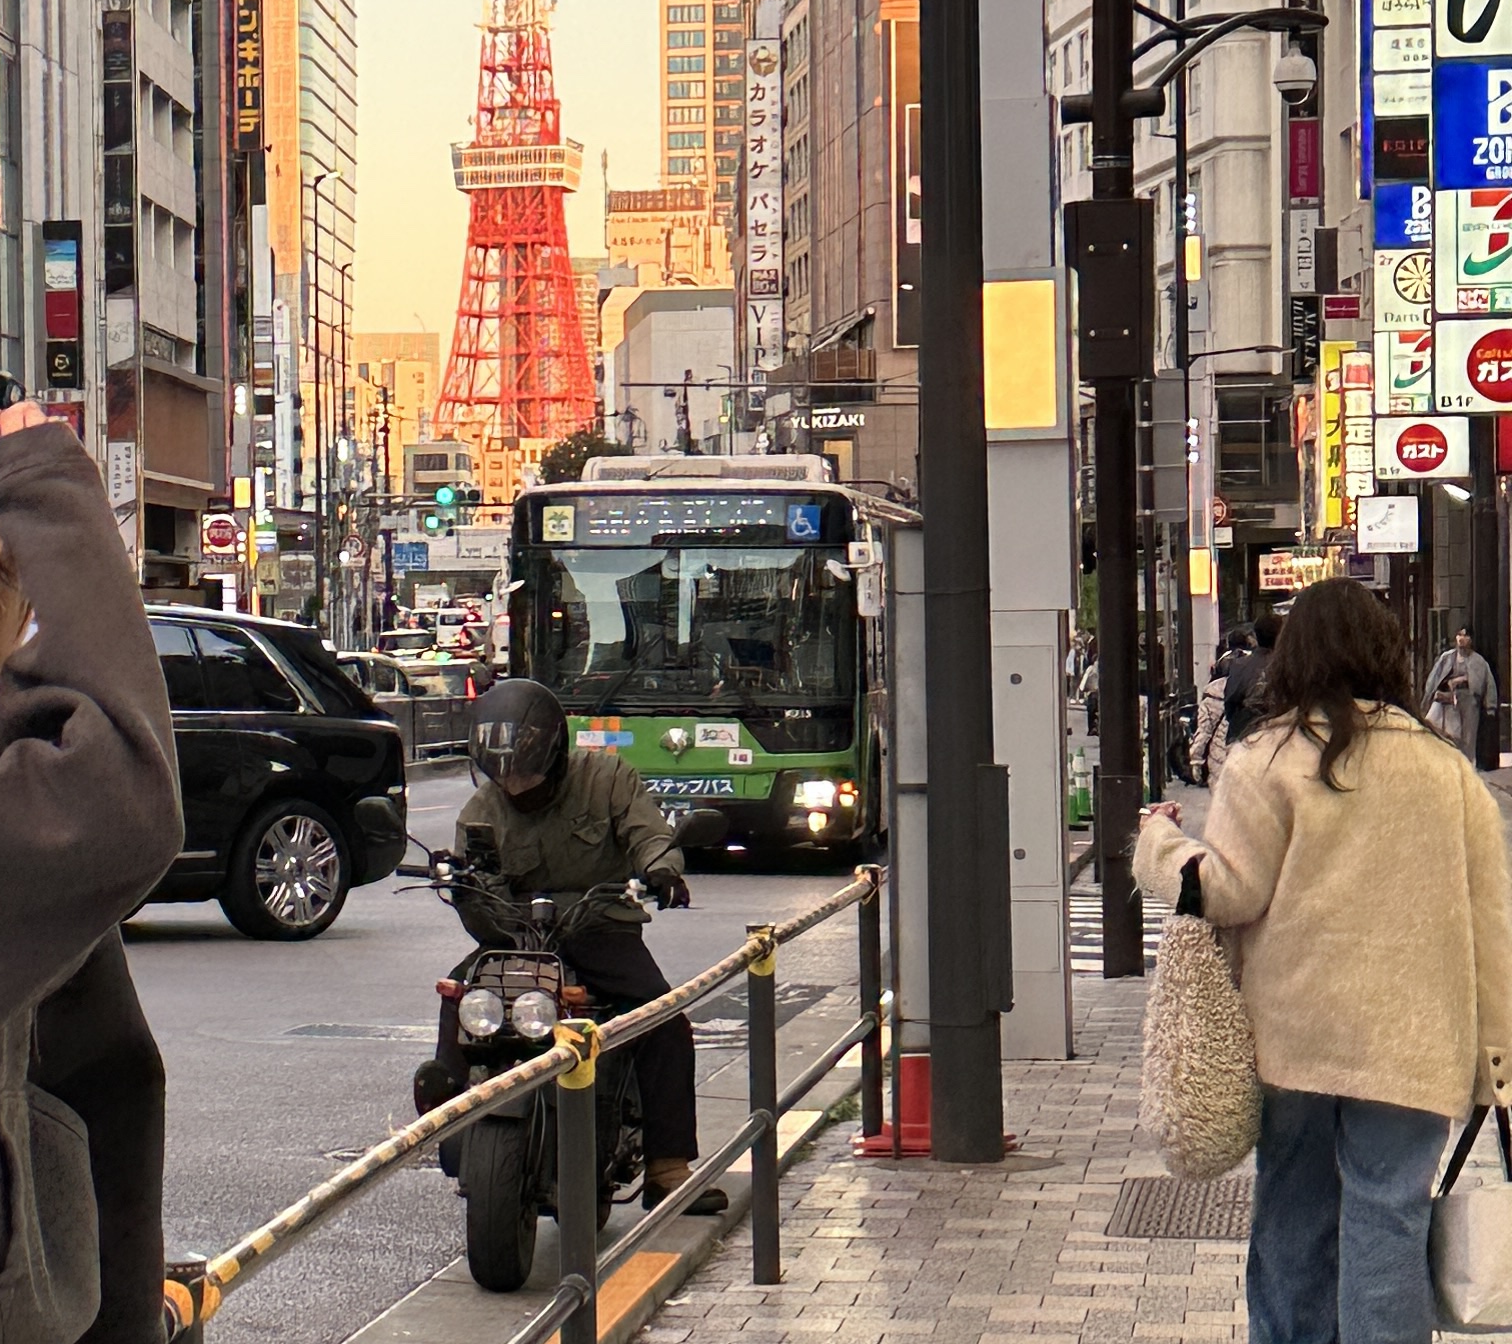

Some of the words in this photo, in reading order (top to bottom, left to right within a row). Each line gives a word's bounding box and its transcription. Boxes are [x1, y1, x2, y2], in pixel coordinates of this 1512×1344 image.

[749, 83, 769, 179] カラオケ
[749, 193, 769, 263] パセラ
[750, 305, 766, 368] VIP
[1402, 442, 1445, 460] ガスト
